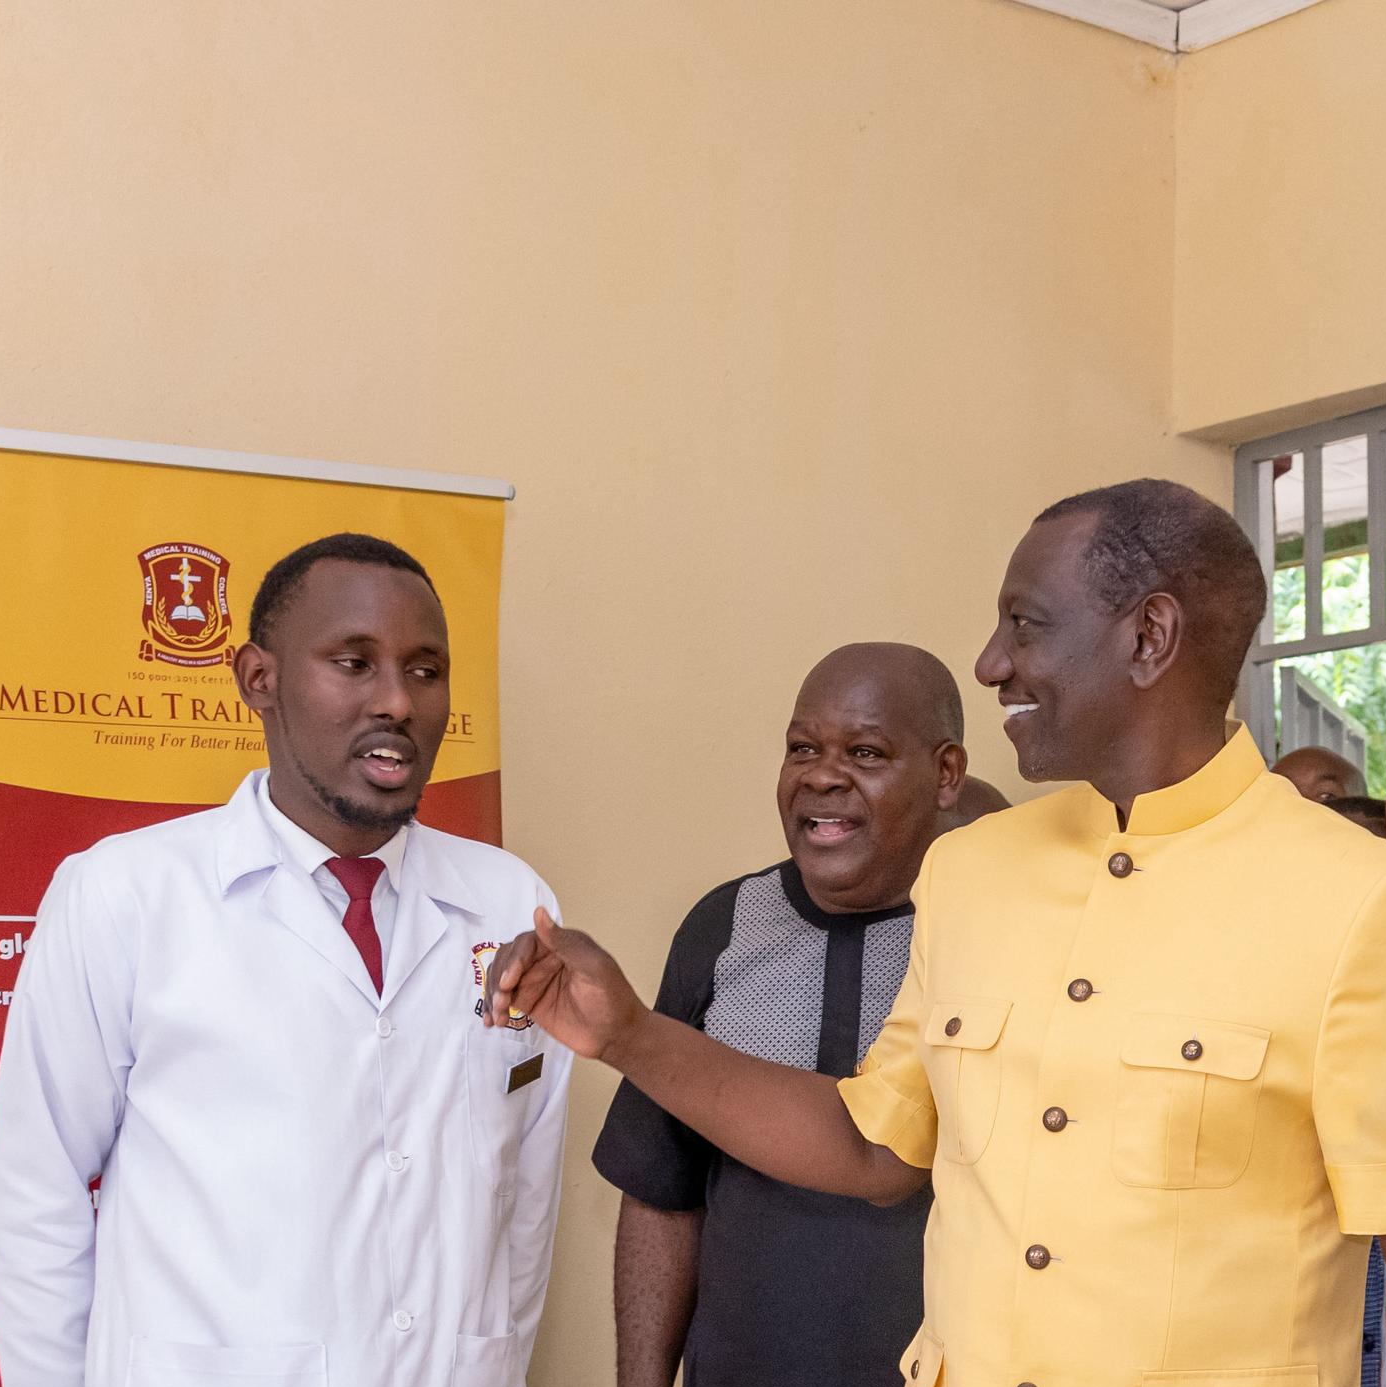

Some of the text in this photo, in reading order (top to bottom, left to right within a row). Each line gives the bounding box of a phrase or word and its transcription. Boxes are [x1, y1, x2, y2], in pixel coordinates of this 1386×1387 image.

[143, 545, 221, 565] MEDICAL TRAINING
[144, 575, 153, 606] KENYA
[218, 576, 228, 615] COLLEGE
[127, 671, 145, 682] ISO
[201, 675, 233, 686] Certif
[162, 692, 264, 724] TRAIN
[93, 730, 267, 752] Training For Better Heal
